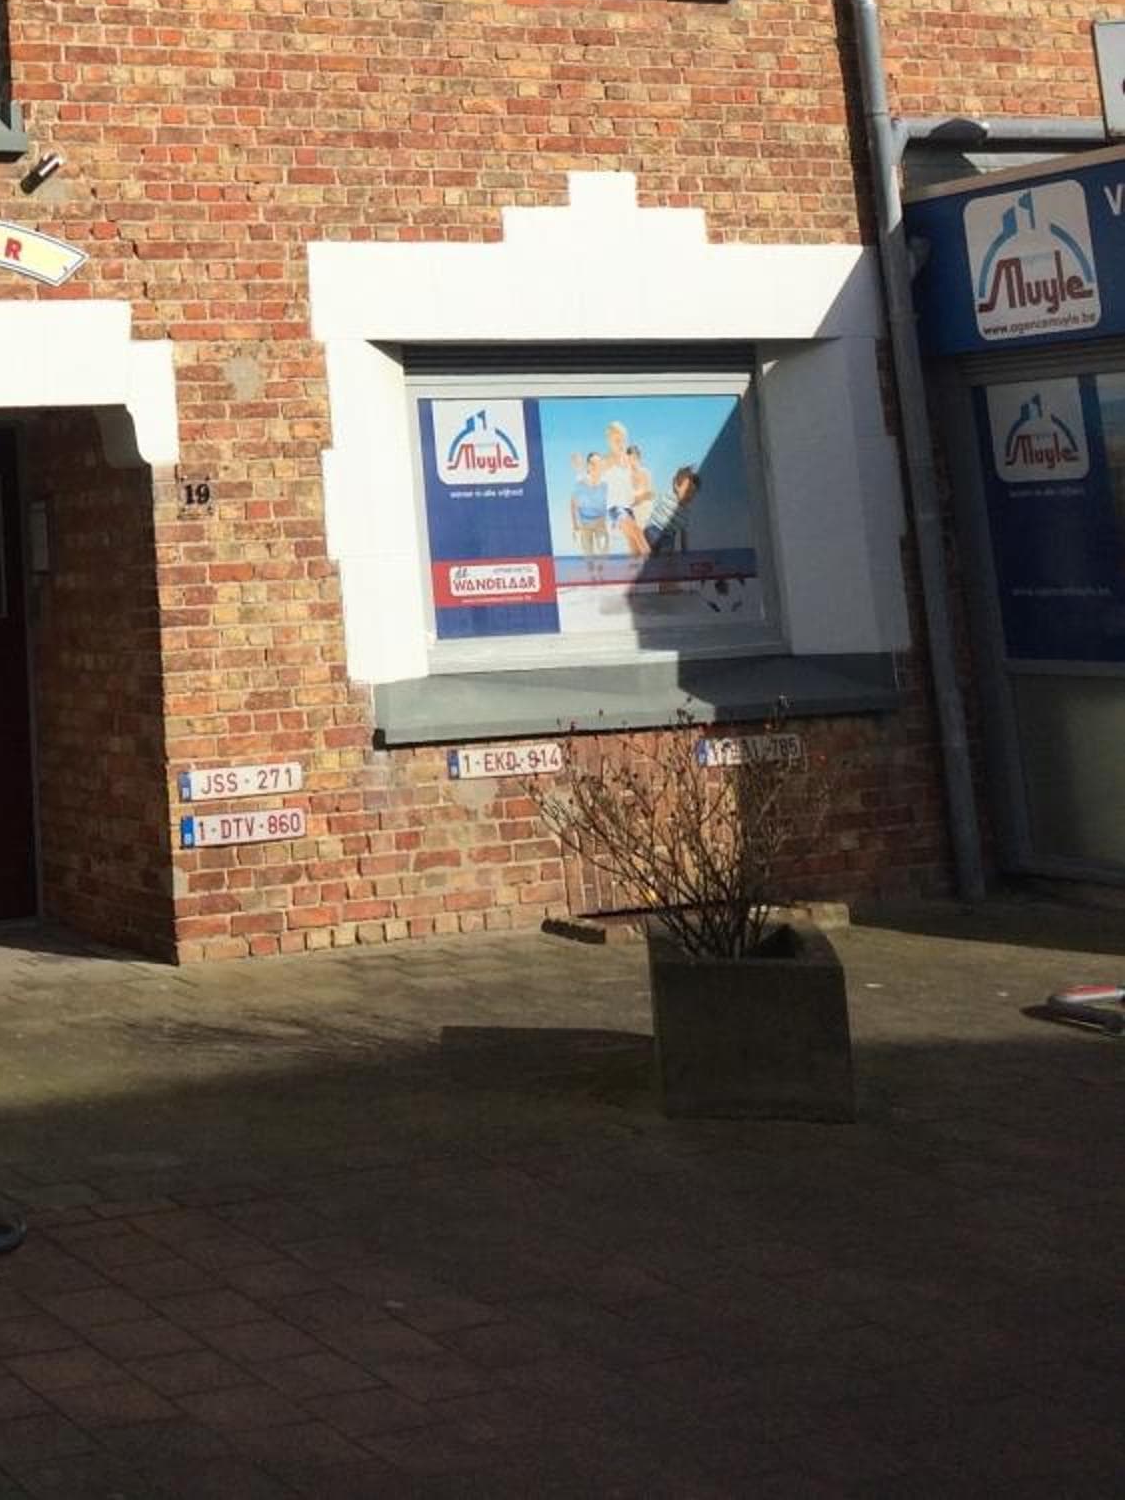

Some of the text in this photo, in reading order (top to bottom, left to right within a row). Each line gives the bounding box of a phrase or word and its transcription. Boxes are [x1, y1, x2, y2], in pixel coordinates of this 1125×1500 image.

[978, 249, 1093, 314] Muyle
[447, 442, 519, 474] Muyle
[1005, 432, 1079, 469] Muyle
[185, 483, 210, 505] 19
[453, 576, 537, 592] WANDELAAR
